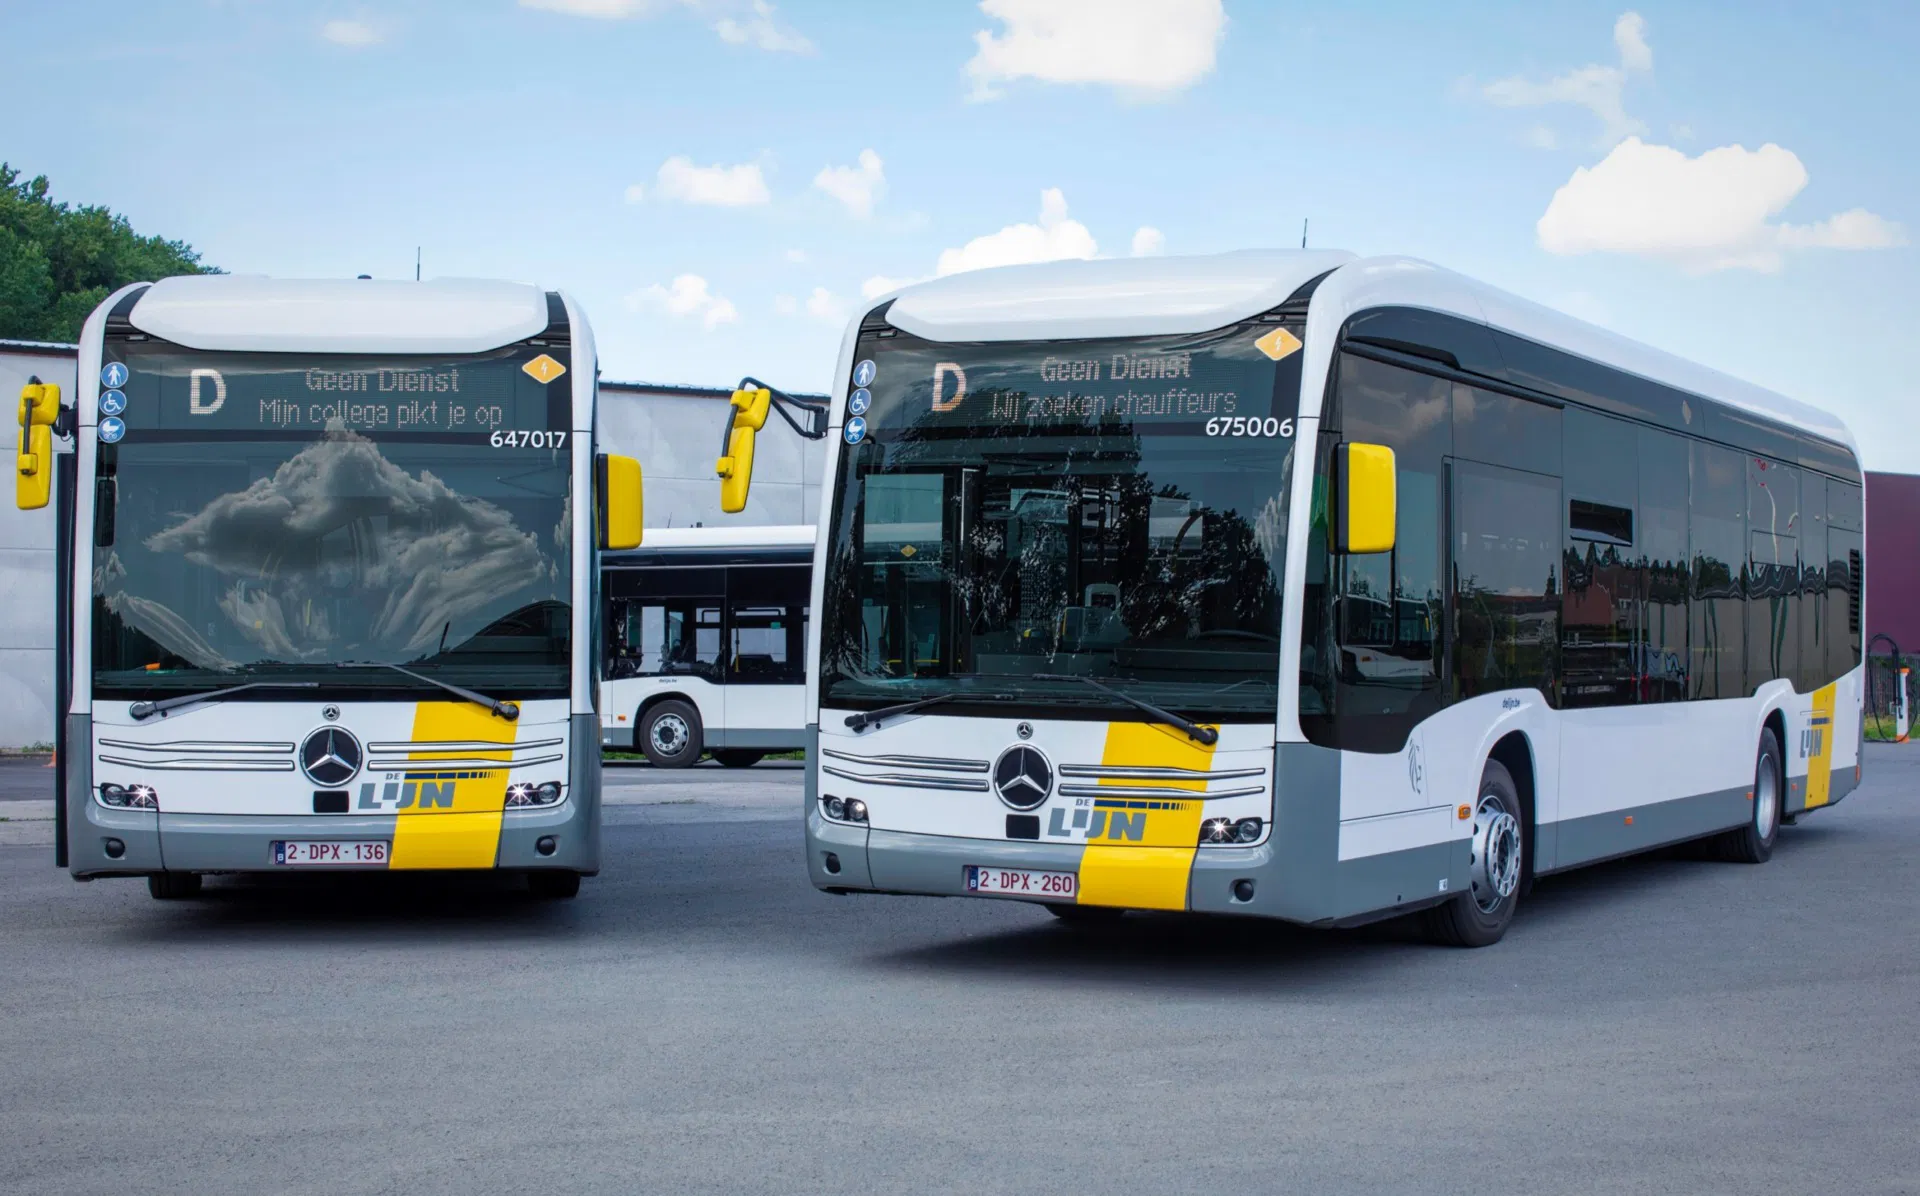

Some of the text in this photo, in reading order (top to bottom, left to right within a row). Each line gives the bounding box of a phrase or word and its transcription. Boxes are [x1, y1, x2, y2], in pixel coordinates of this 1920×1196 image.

[305, 367, 459, 392] Geen Dienst
[1040, 352, 1191, 382] Geen Dienst
[189, 368, 227, 414] D
[931, 362, 967, 412] D
[259, 399, 502, 430] Mijn collega pikt je op
[992, 388, 1237, 423] Wij zoeken chauffeurs
[490, 430, 566, 449] 647017
[1205, 415, 1293, 437] 675006
[385, 773, 400, 781] DE
[358, 781, 456, 810] LIJN
[1075, 798, 1090, 807] DE
[1047, 807, 1147, 842] LIJN
[277, 844, 384, 861] B 2-DPX-136
[970, 870, 1072, 893] B 2-DPX-260
